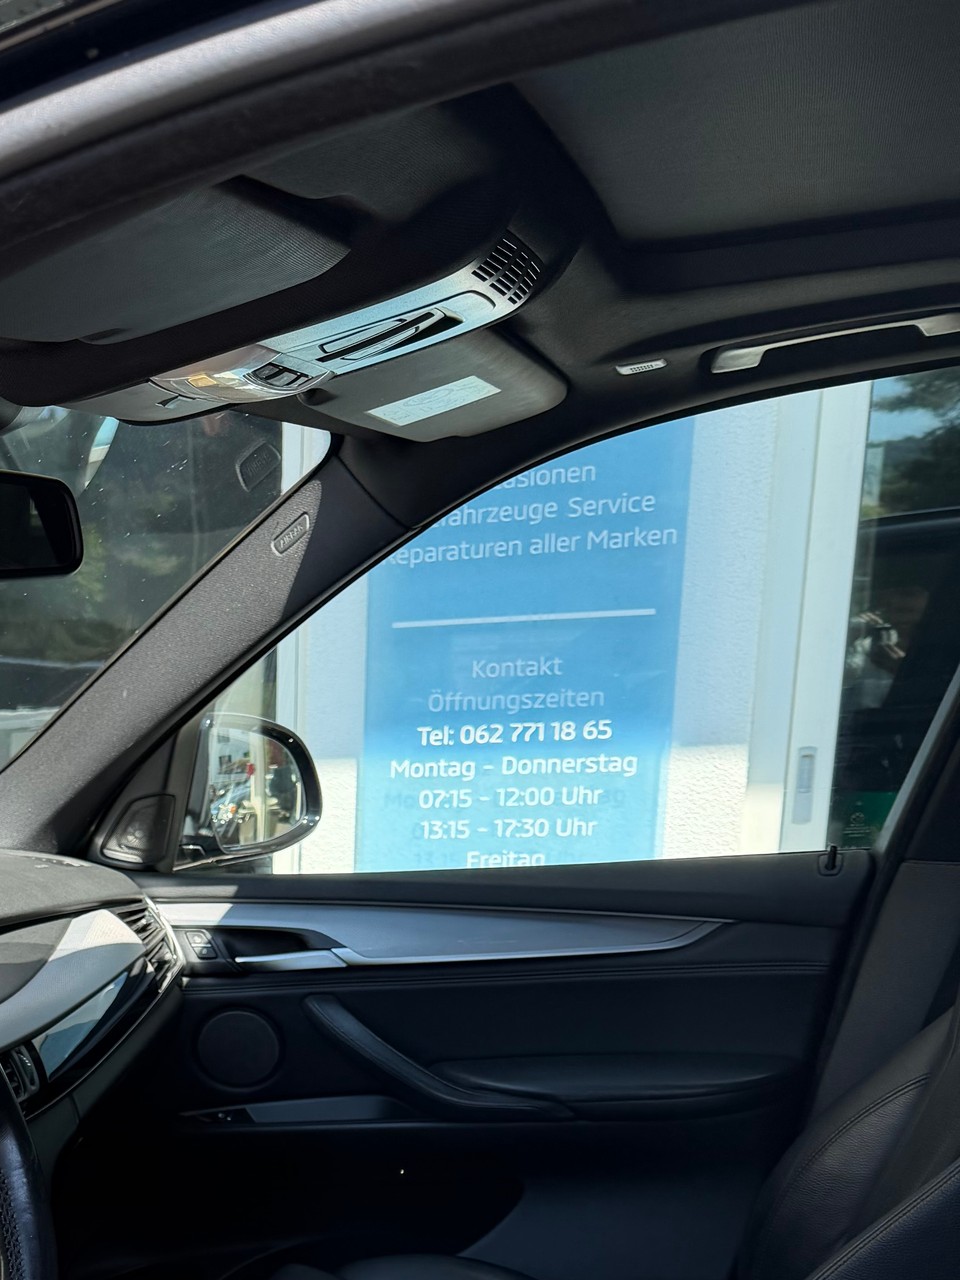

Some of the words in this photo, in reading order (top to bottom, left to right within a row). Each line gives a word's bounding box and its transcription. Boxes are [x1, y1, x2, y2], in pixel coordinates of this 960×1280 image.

[496, 465, 596, 490] asionen
[568, 492, 656, 518] Service
[529, 533, 581, 555] aller
[587, 526, 677, 550] Marken
[472, 657, 563, 679] Kontakt
[428, 688, 604, 714] Öffnungszeiten
[417, 725, 454, 746] Tel:
[460, 724, 503, 745] 062
[510, 722, 544, 742] 771
[551, 721, 576, 741] 18
[583, 719, 613, 740] 65
[390, 759, 476, 782] Montag
[501, 753, 638, 777] Donnerstag
[419, 789, 472, 809] 07:15
[496, 786, 555, 807] 12:00
[561, 785, 604, 805] Uhr
[420, 820, 471, 840] 13:15
[493, 818, 549, 838] 17:30
[556, 817, 598, 837] Uhr
